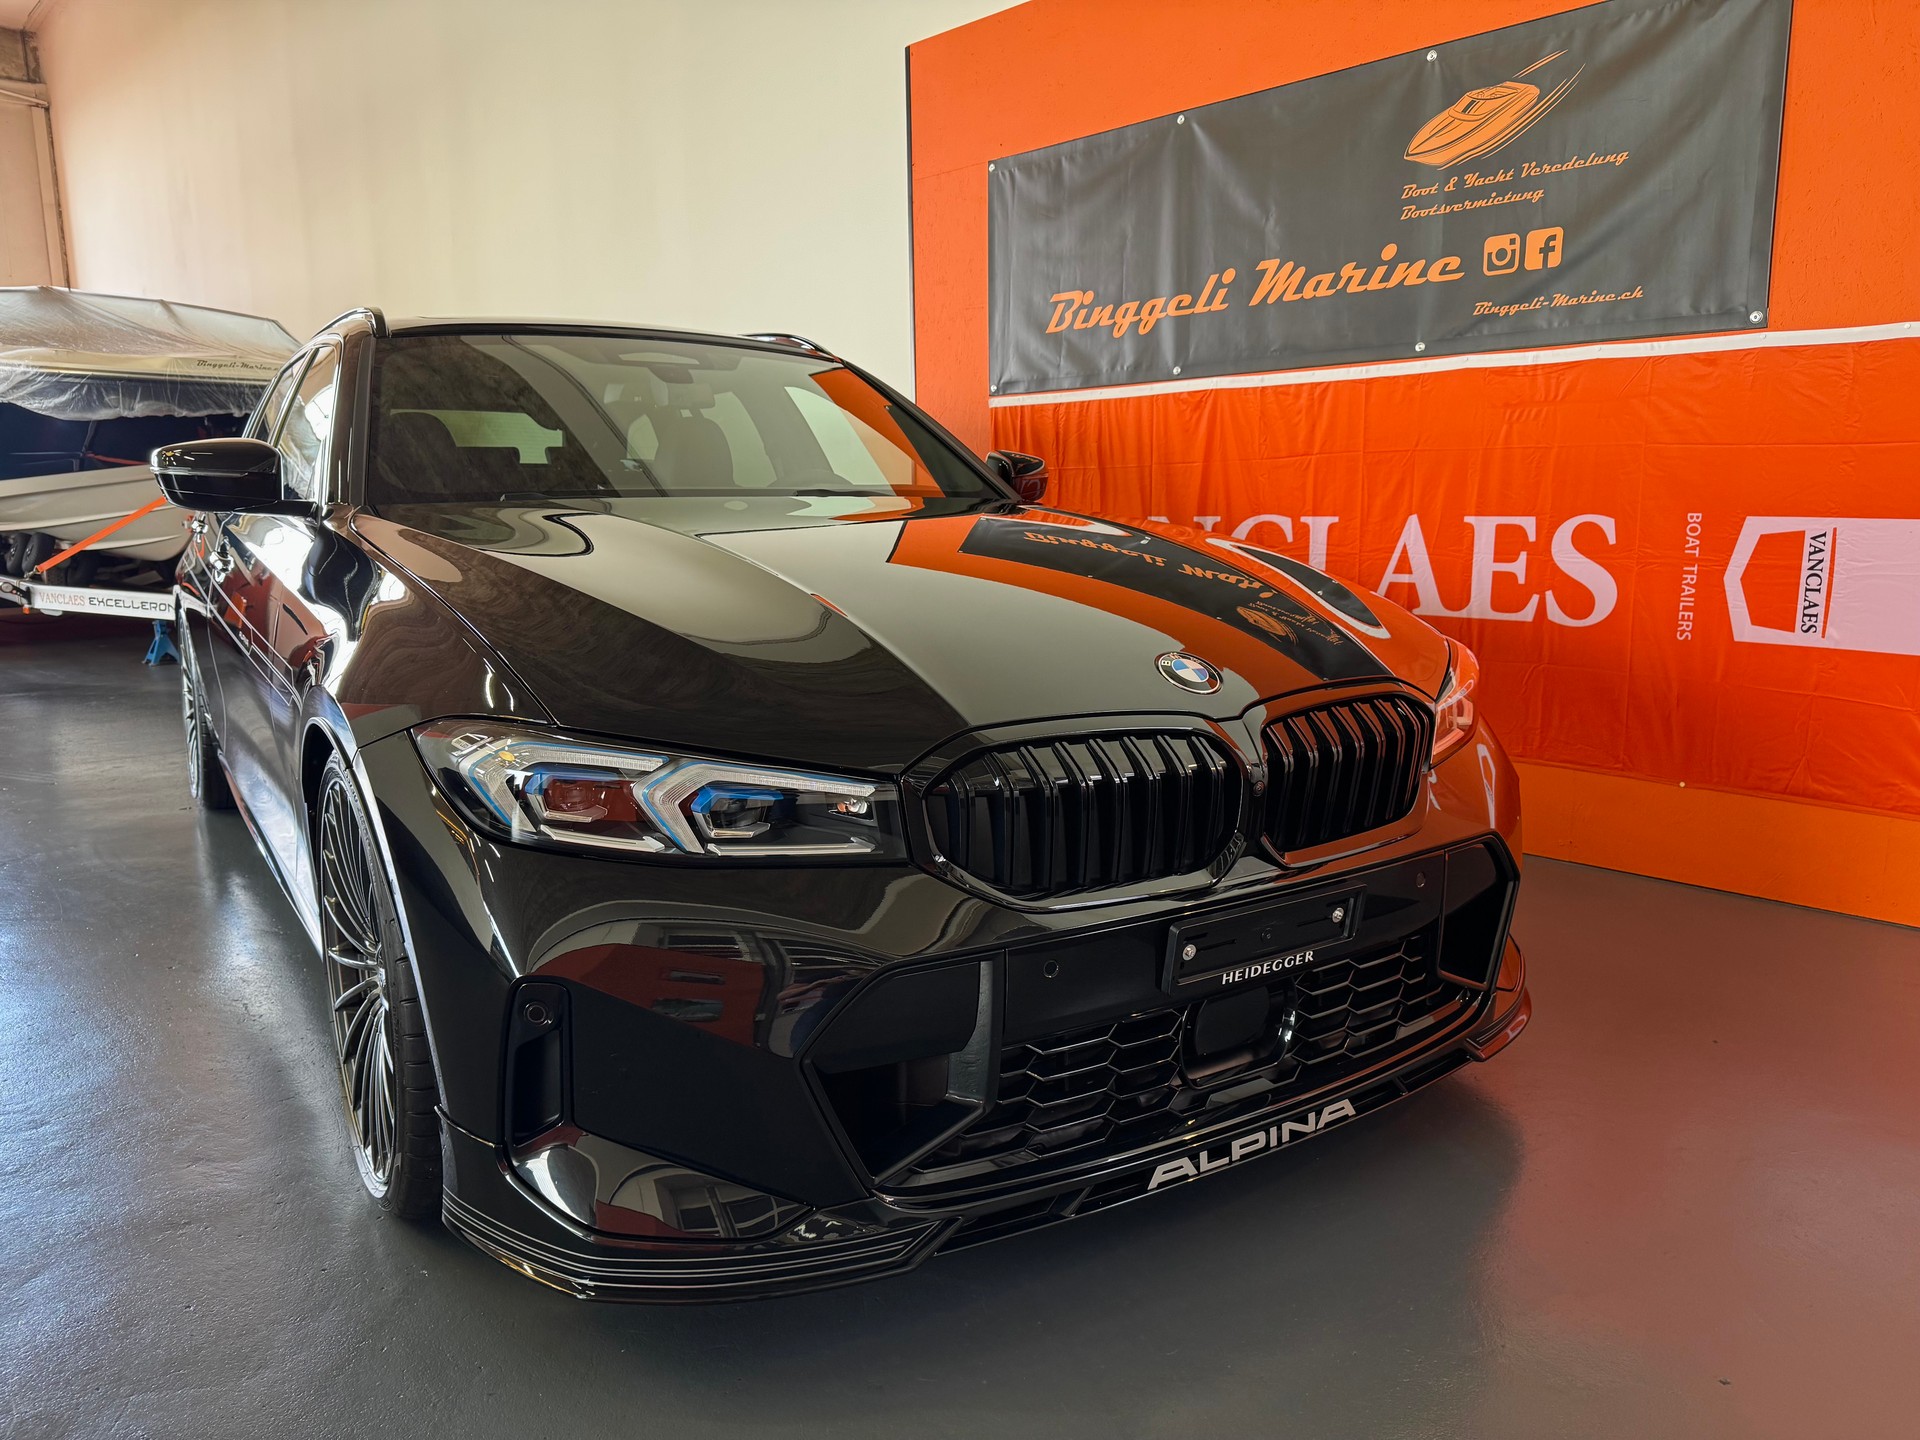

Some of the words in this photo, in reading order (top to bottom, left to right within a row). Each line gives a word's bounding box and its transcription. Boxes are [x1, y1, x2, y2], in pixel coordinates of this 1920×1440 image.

[1401, 183, 1439, 200] Boot
[1443, 177, 1457, 192] &
[1464, 168, 1515, 190] Yacht
[1521, 150, 1629, 179] Veredelung
[1400, 188, 1545, 221] Bootsvermietung
[1045, 267, 1238, 339] Binggeli
[1247, 242, 1466, 308] Marine
[1472, 285, 1644, 317] Binggeli-Marine.ch
[1684, 511, 1703, 557] BOAT
[39, 591, 86, 607] VANCLAES
[88, 596, 175, 612] EXCELLERON
[1676, 563, 1698, 641] TRAILERS
[1800, 530, 1828, 635] VANCLAES
[1221, 950, 1314, 985] HEIDEGGER
[1147, 1098, 1357, 1191] ALPINA
